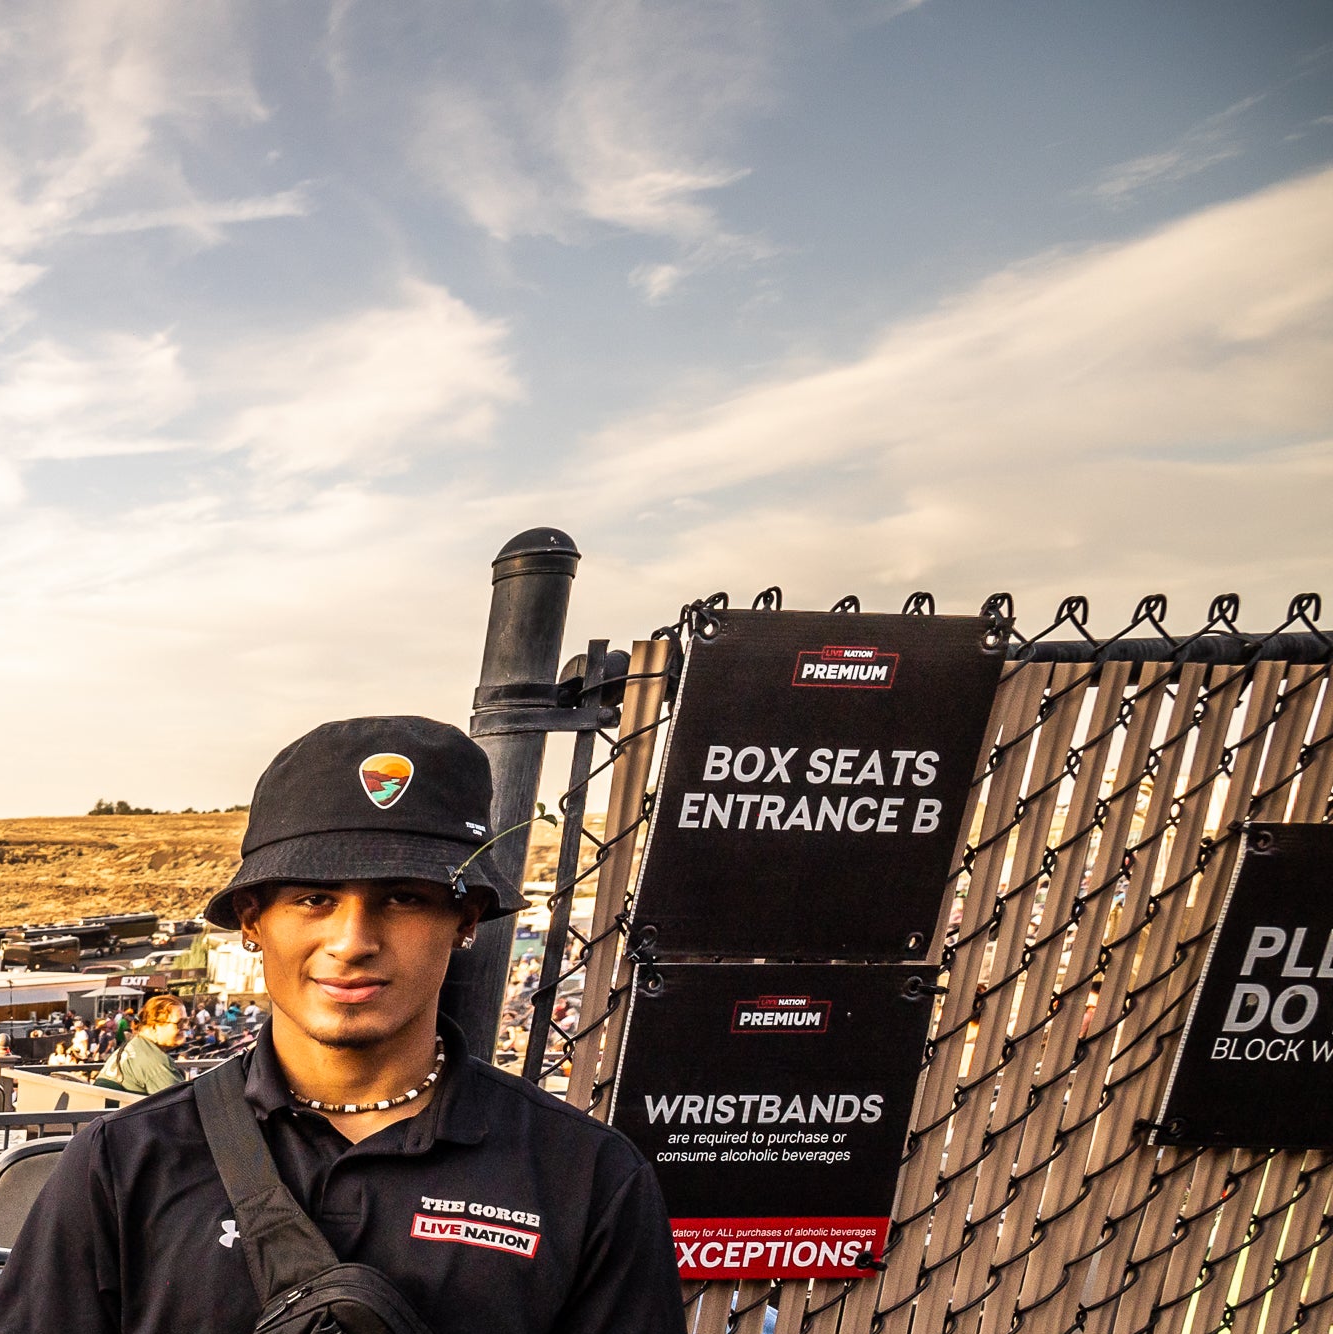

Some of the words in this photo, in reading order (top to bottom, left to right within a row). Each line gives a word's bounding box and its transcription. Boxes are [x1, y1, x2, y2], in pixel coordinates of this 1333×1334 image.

[825, 649, 843, 657] LIVE
[843, 649, 874, 658] NATION
[801, 663, 888, 681] PREMIUM
[702, 745, 799, 784] BOX
[805, 747, 940, 787] SEATS
[678, 792, 905, 833] ENTRANCE
[911, 798, 943, 834] B
[120, 975, 150, 986] EXIT
[778, 998, 806, 1006] NATION
[1221, 983, 1319, 1035] DO
[739, 1011, 821, 1026] PREMIUM
[1210, 1037, 1305, 1062] BLOCK
[644, 1094, 884, 1125] WRISTBANDS
[668, 1134, 690, 1144] are
[693, 1131, 748, 1147] required
[751, 1132, 764, 1144] to
[767, 1131, 829, 1147] purchase
[832, 1133, 847, 1144] or
[656, 1151, 717, 1162] consume
[720, 1149, 779, 1162] alcoholic
[782, 1149, 851, 1164] beverages
[421, 1196, 466, 1213] THE
[468, 1202, 541, 1228] GORGE
[420, 1221, 462, 1236] LIVE
[464, 1226, 530, 1251] NATION
[702, 1228, 714, 1237] for
[716, 1228, 734, 1237] ALL
[736, 1228, 782, 1239] purchases
[784, 1228, 793, 1237] of
[830, 1228, 877, 1239] beverages
